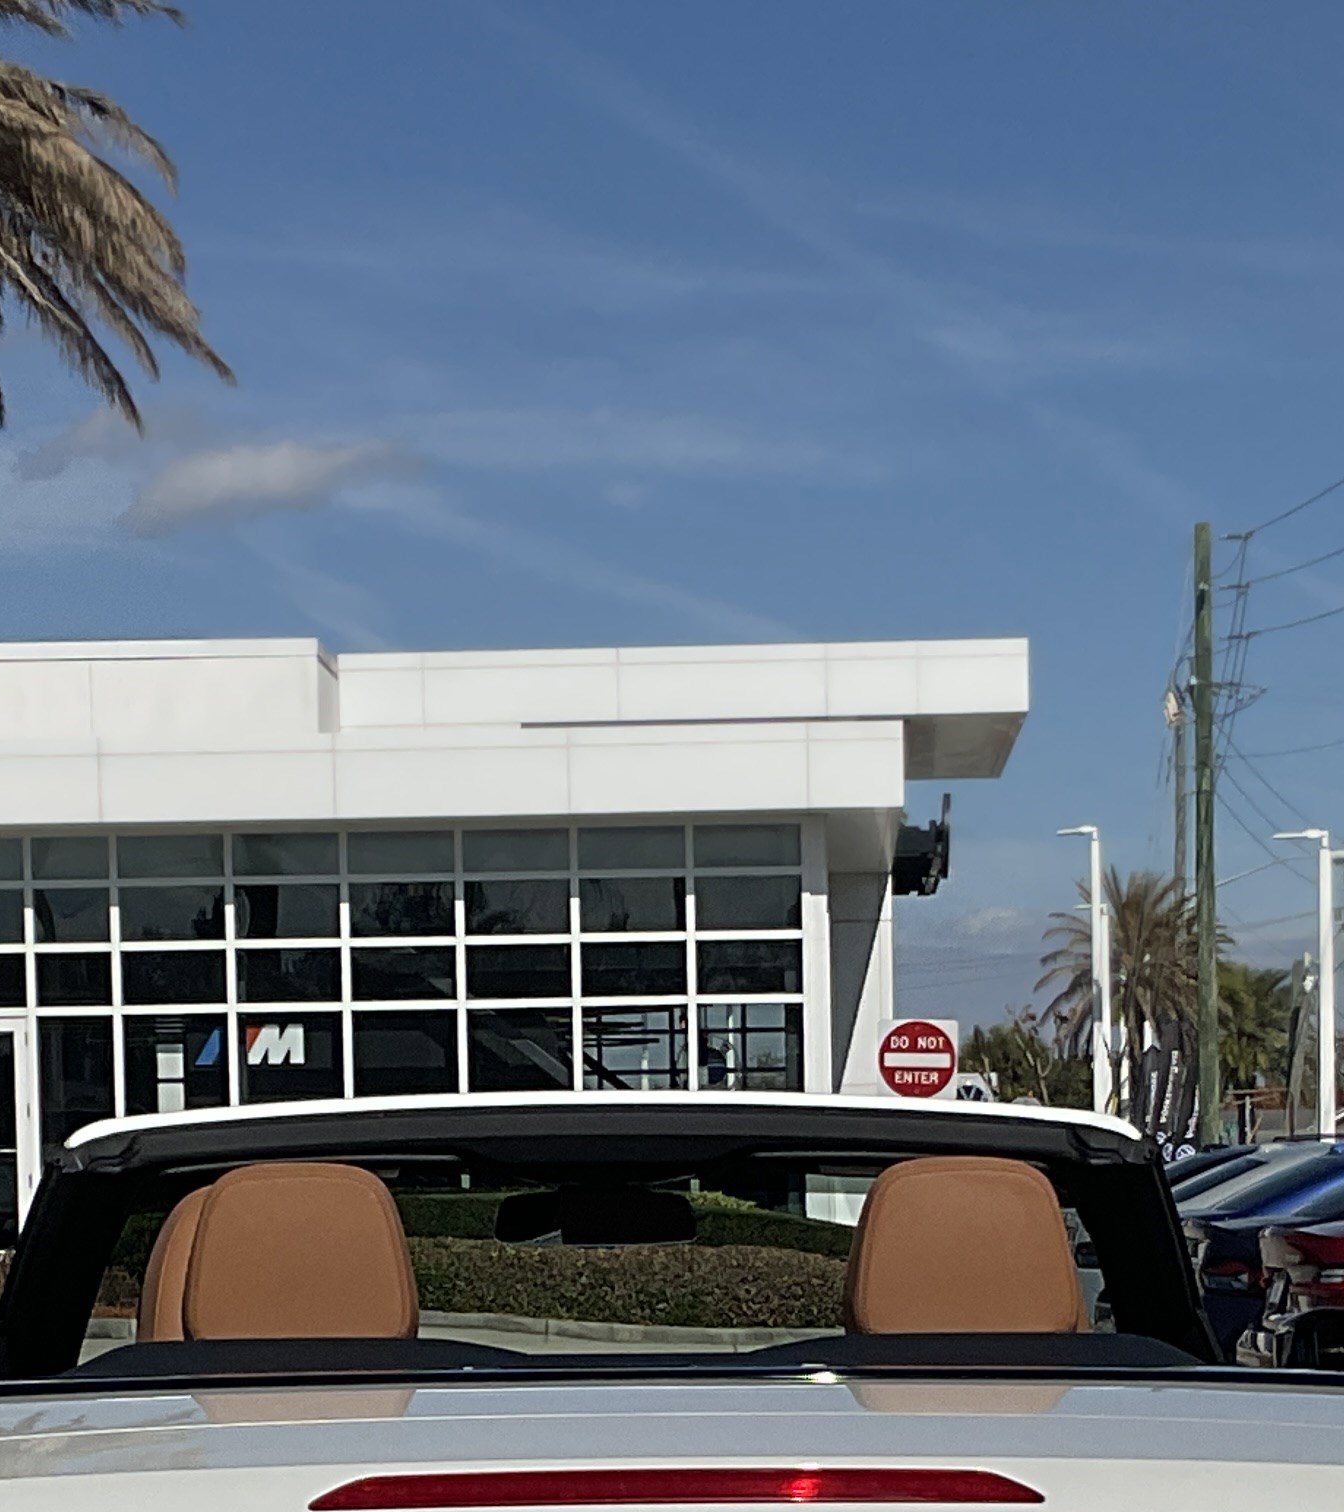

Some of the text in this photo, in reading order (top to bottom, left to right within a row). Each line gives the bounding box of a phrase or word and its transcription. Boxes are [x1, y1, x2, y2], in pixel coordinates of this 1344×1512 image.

[890, 1035, 946, 1050] DO NOT
[894, 1071, 939, 1085] ENTER
